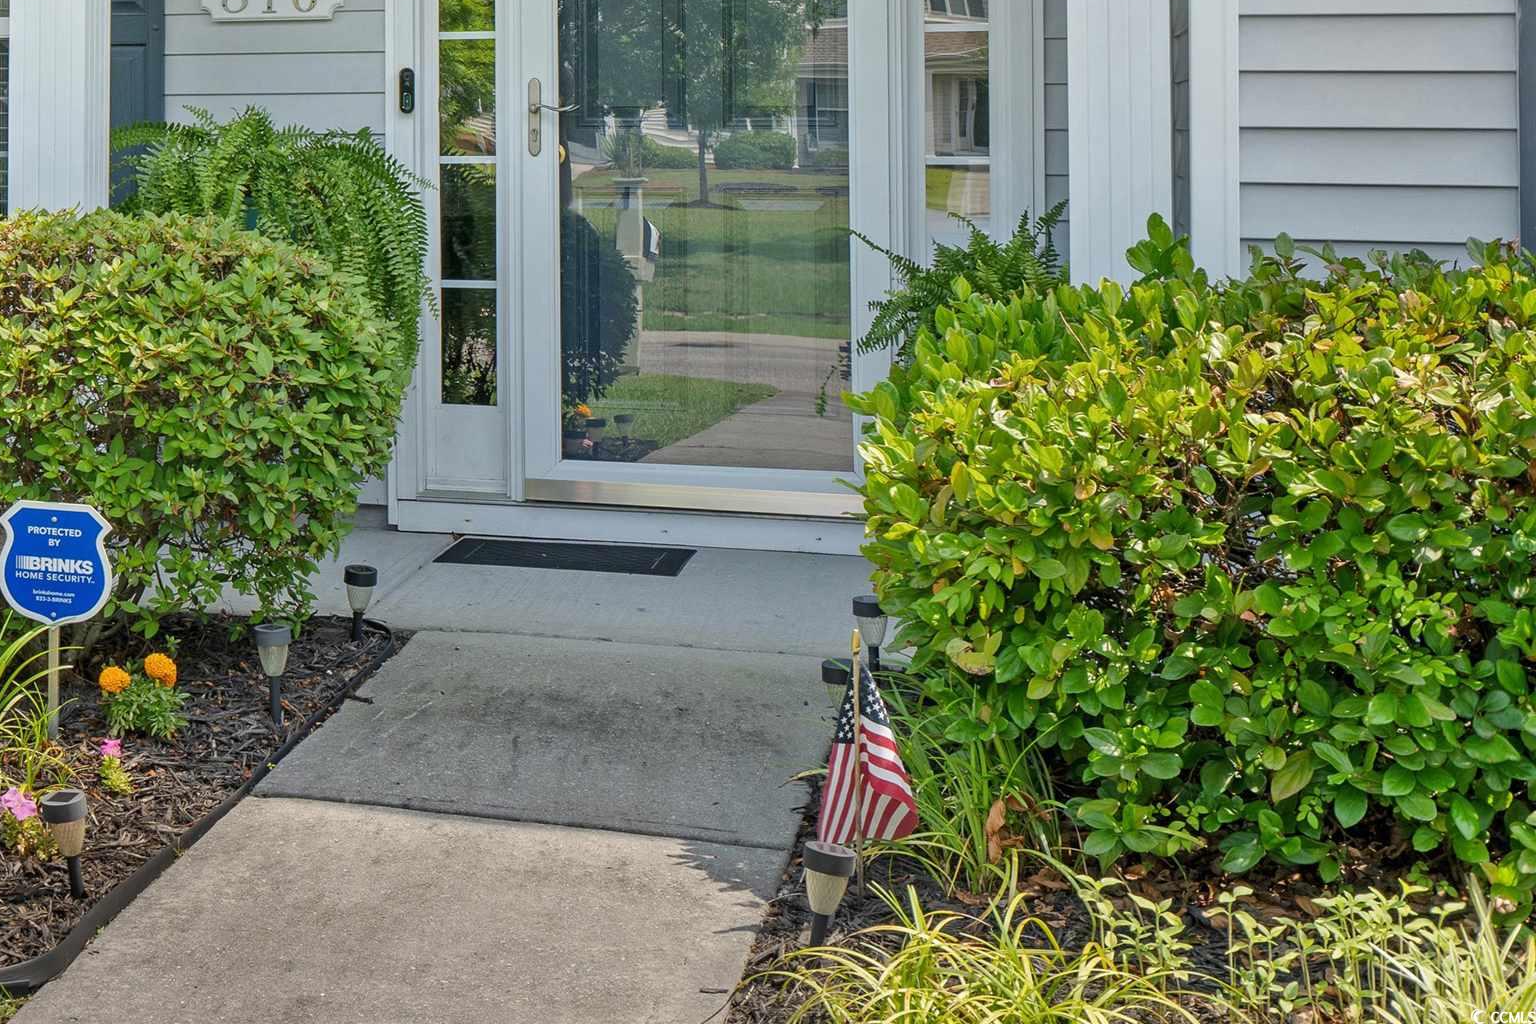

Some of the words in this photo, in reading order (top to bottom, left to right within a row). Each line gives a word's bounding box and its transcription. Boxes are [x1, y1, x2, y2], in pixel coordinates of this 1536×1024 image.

[27, 525, 82, 538] PROTECTED
[48, 538, 61, 547] BY
[30, 555, 94, 575] BRINKS
[15, 570, 44, 580] HOME
[46, 572, 92, 584] SECURITY
